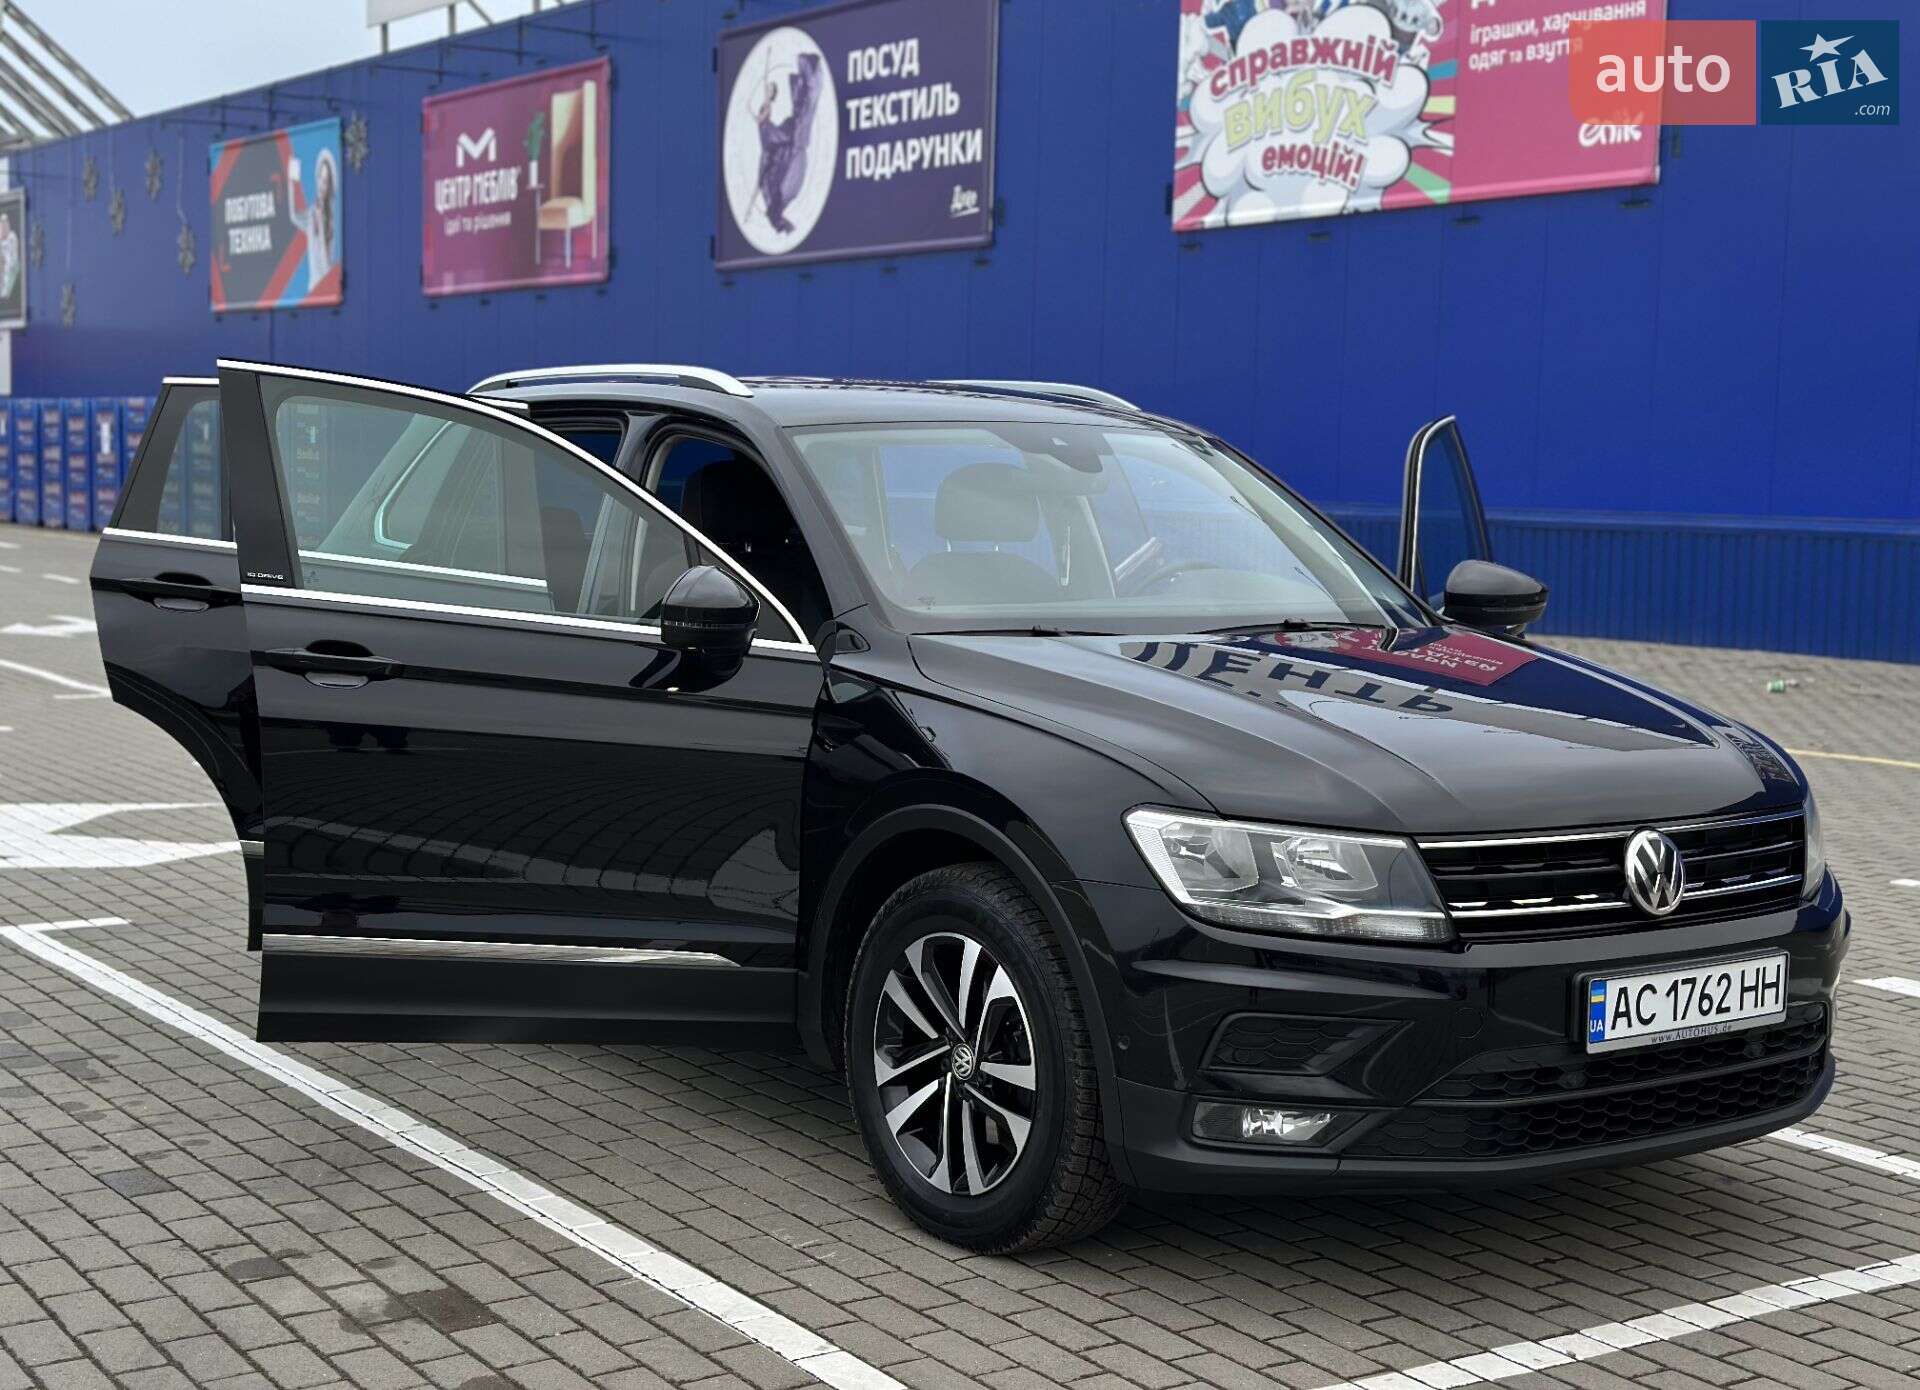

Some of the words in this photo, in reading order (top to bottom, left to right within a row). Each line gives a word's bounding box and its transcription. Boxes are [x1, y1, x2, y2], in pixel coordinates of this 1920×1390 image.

[1469, 19, 1540, 47] іграшки,
[1542, 0, 1647, 35] харчування
[847, 37, 920, 84] ПОСУД
[1210, 35, 1399, 97] справжній
[1468, 49, 1506, 73] одяг
[1509, 50, 1524, 64] та
[1525, 37, 1583, 64] взуття
[845, 81, 961, 132] ТЕКСТИЛЬ
[1223, 69, 1379, 148] вибух
[846, 127, 984, 181] ПОДАРУНКИ
[1261, 140, 1366, 187] емоцій!
[434, 173, 472, 215] ЦЕНТР
[1610, 983, 1658, 1031] AC
[1665, 972, 1733, 1022] 1762
[1739, 963, 1781, 1012] HH
[1589, 1018, 1604, 1033] UA
